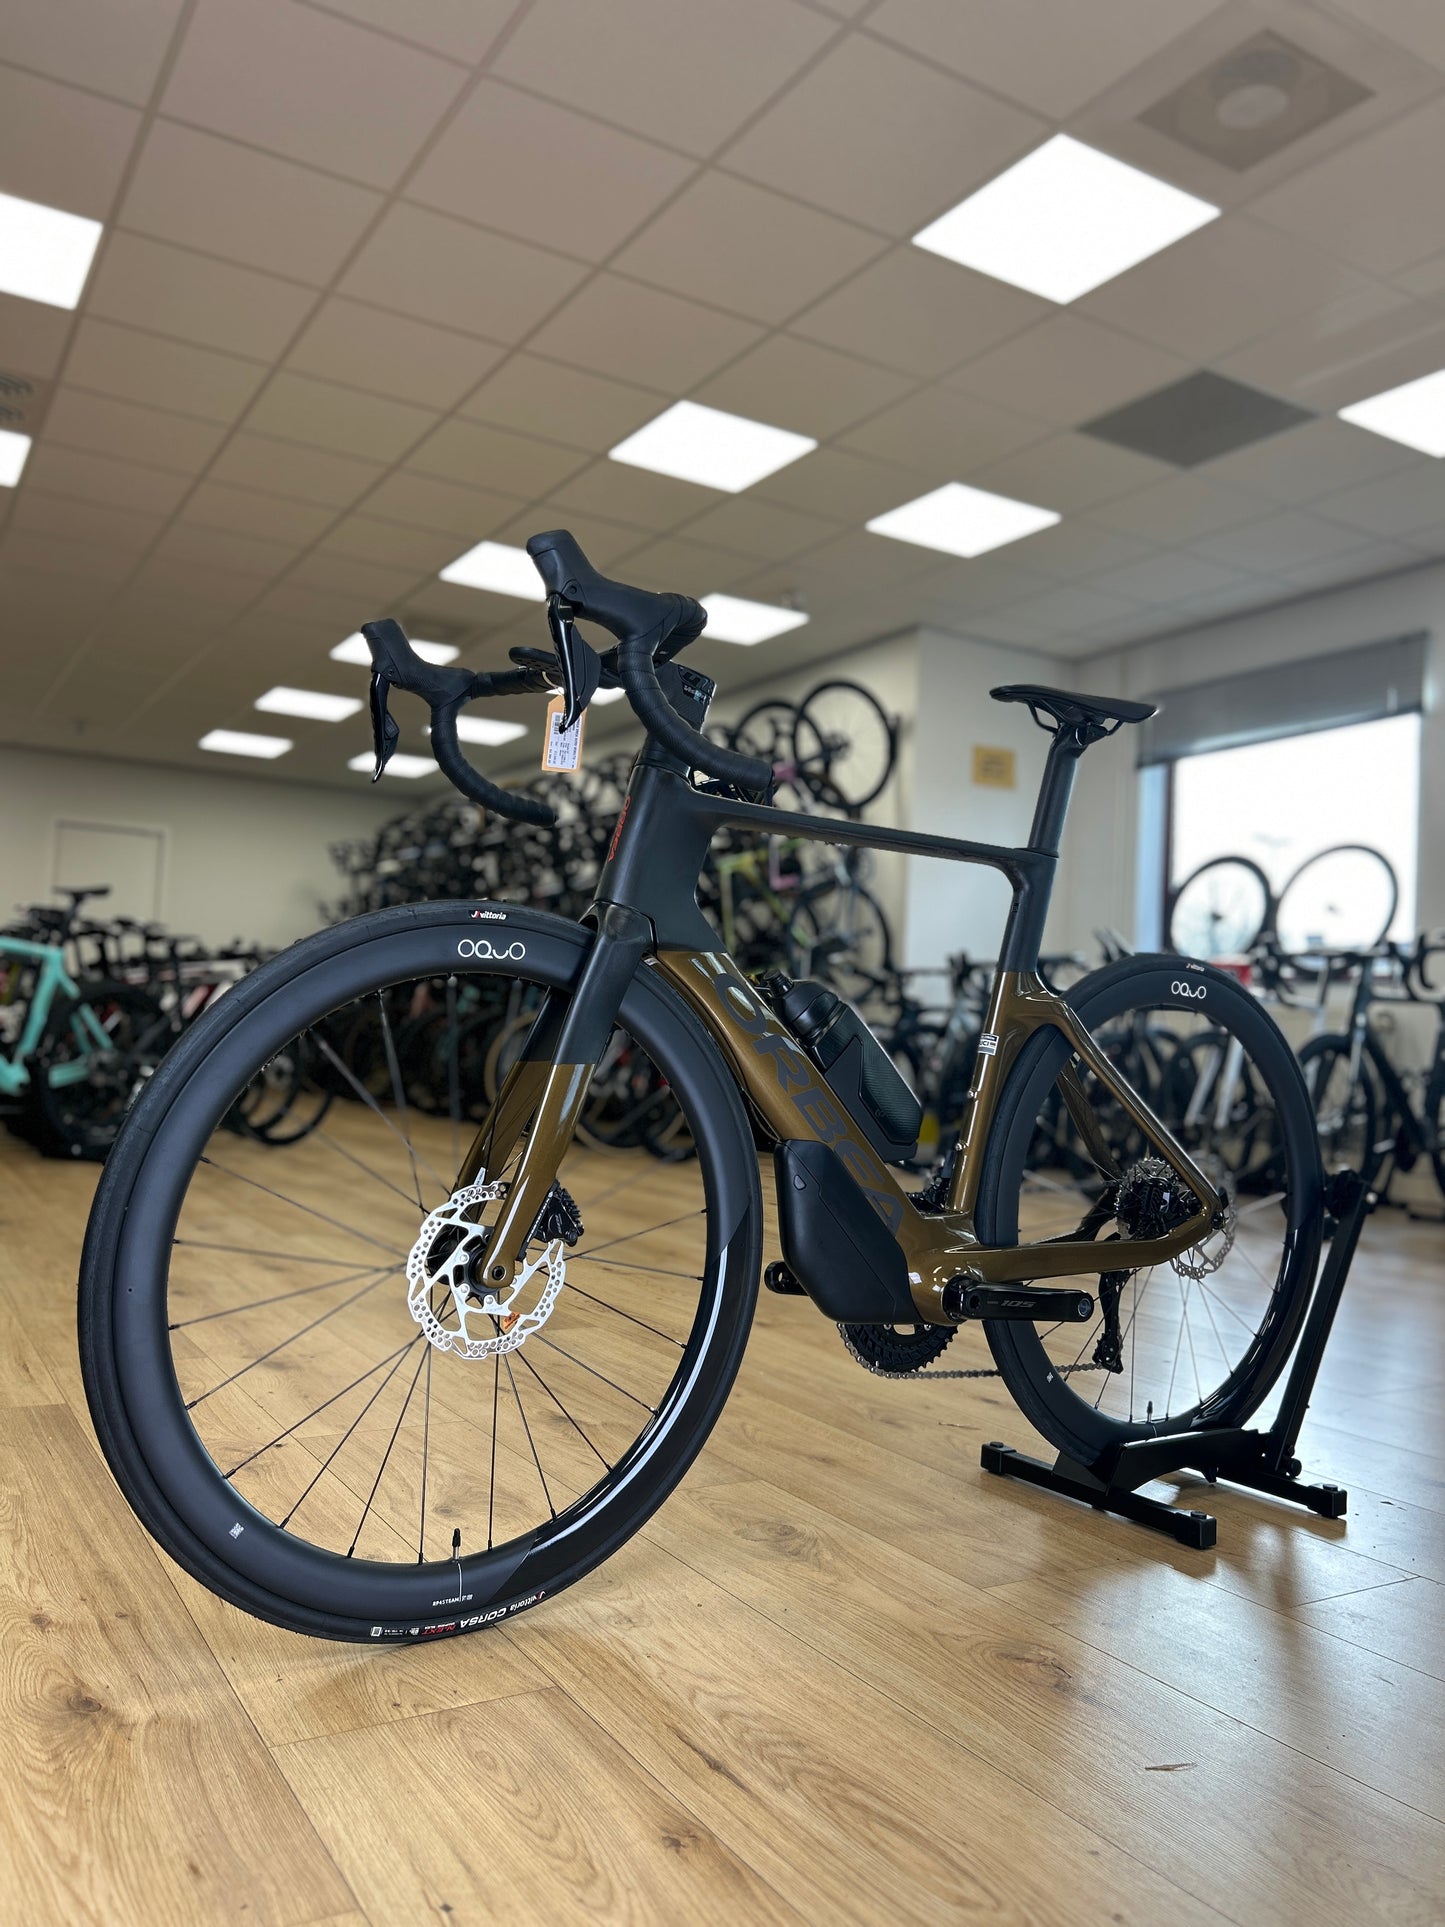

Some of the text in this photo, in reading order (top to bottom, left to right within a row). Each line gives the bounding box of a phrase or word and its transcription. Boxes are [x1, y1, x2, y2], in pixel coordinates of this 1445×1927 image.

[713, 972, 905, 1237] ORBEA
[1001, 1299, 1037, 1308] 105
[460, 1607, 506, 1628] CORSA
